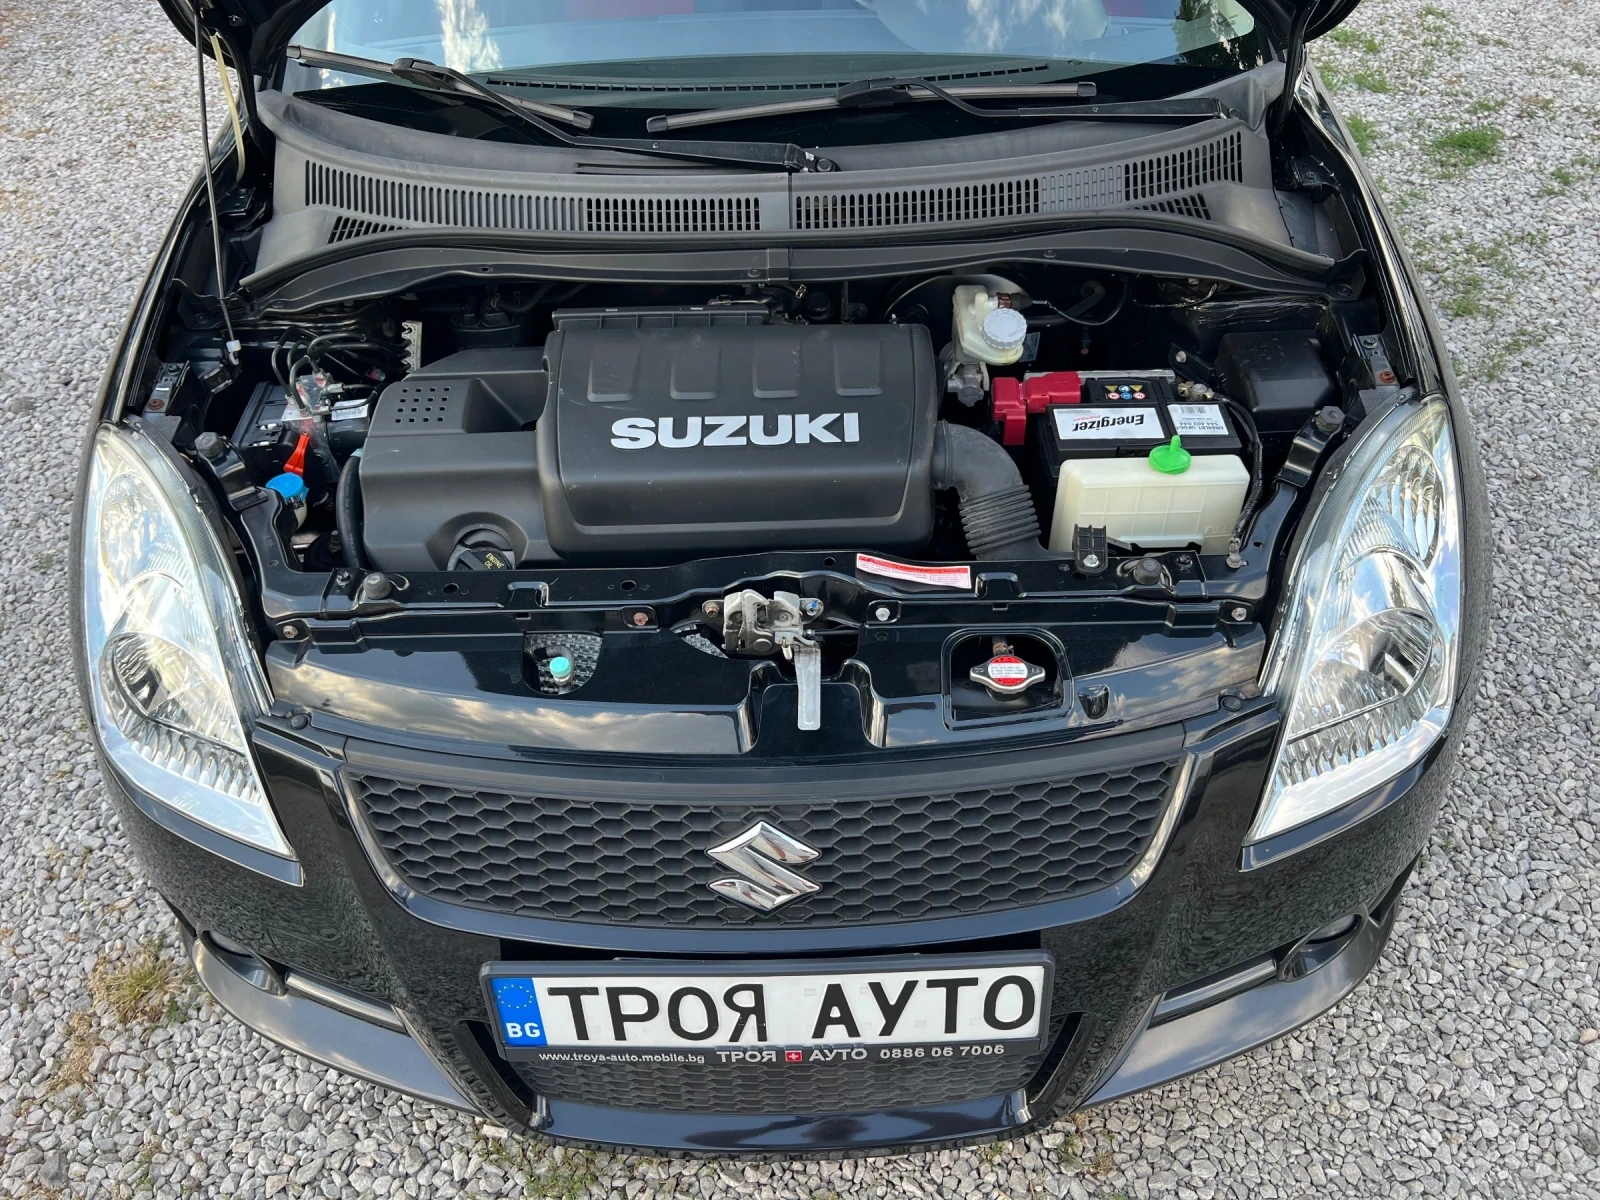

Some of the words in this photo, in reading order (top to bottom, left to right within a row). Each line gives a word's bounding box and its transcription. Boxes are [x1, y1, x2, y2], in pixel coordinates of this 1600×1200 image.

[610, 412, 860, 449] SUZUKI
[1072, 413, 1145, 432] Energizer
[547, 983, 768, 1043] ТРОЯ
[811, 974, 1036, 1040] АУТО
[505, 1022, 541, 1039] BG
[538, 1051, 705, 1064] www.troya-auto.mobile.bg
[715, 1050, 777, 1063] ТРОЯ
[809, 1048, 868, 1062] АУТО
[879, 1048, 925, 1059] 0886
[930, 1046, 954, 1058] 06
[959, 1044, 1005, 1056] 7006
